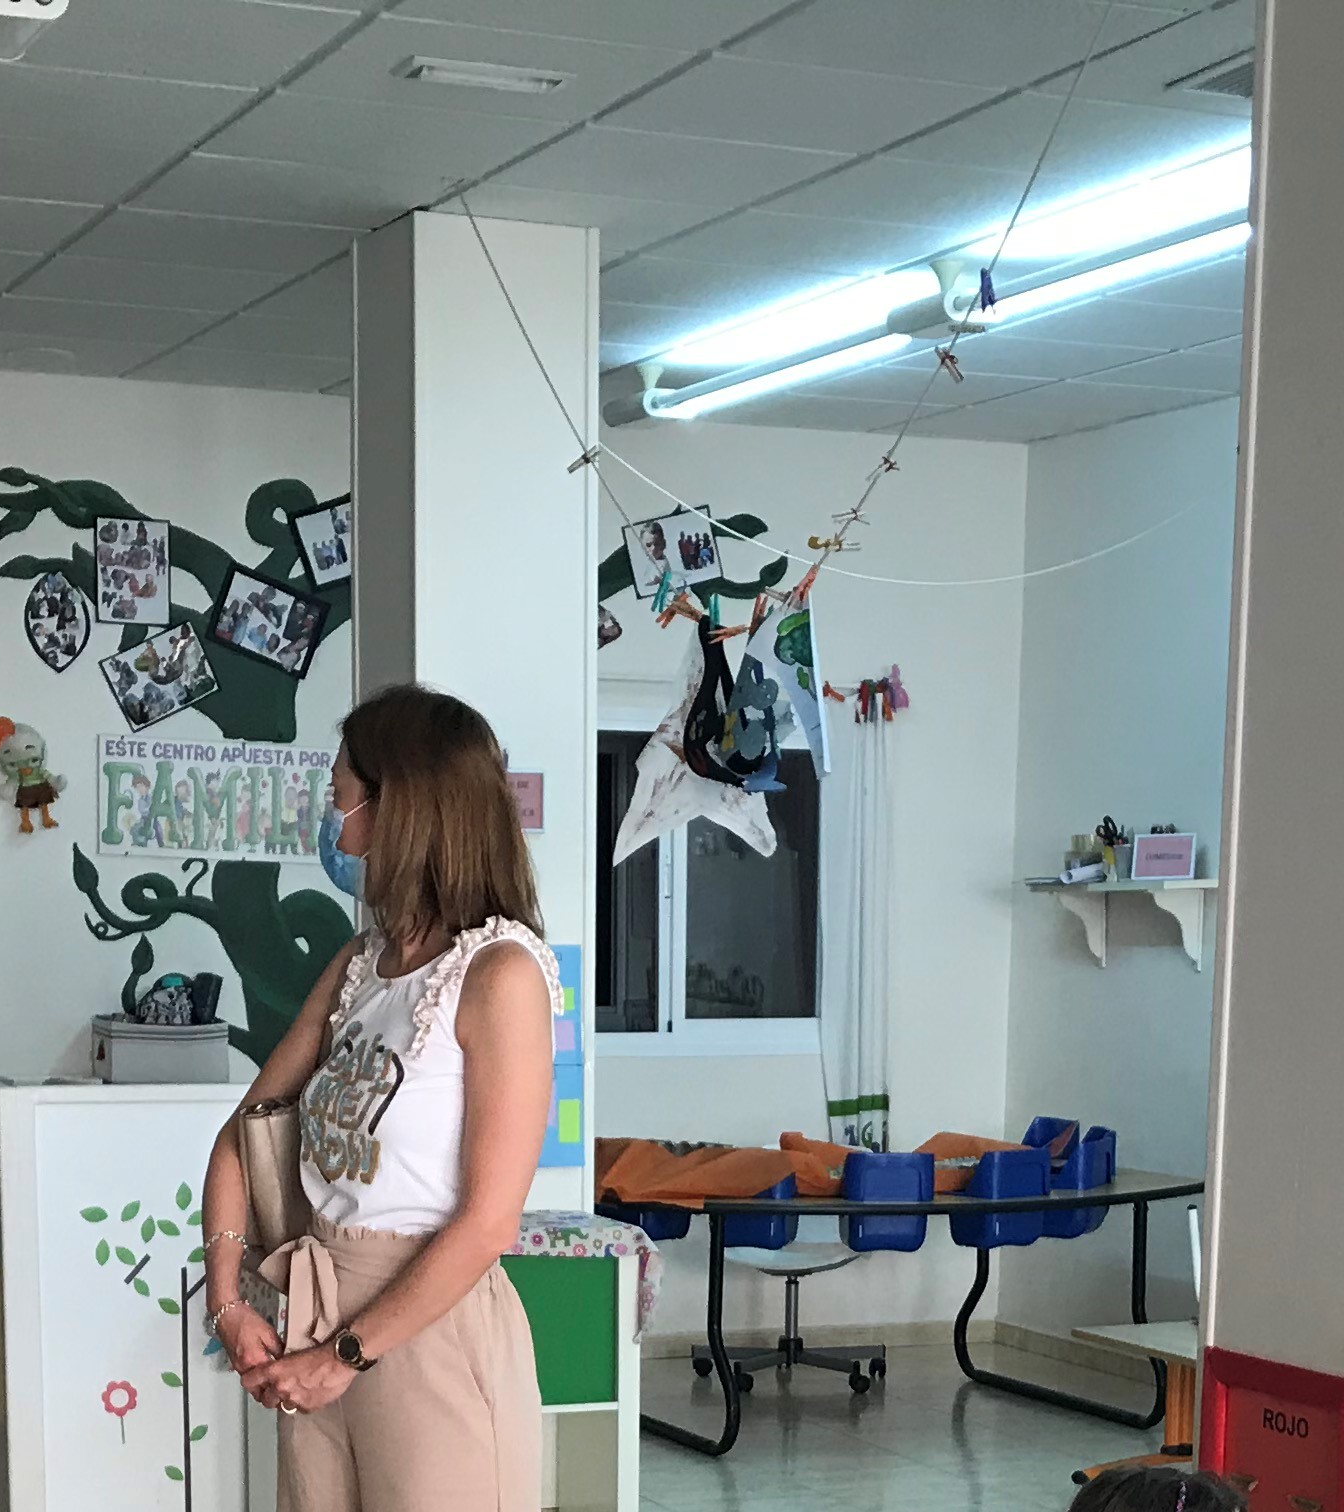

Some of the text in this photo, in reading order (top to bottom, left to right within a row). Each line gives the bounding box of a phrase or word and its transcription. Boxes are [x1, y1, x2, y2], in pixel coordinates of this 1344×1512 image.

[105, 740, 331, 768] ESTE CENTRO APUESTA POR
[102, 761, 324, 852] FAMILI
[1262, 1408, 1309, 1439] ROJO
